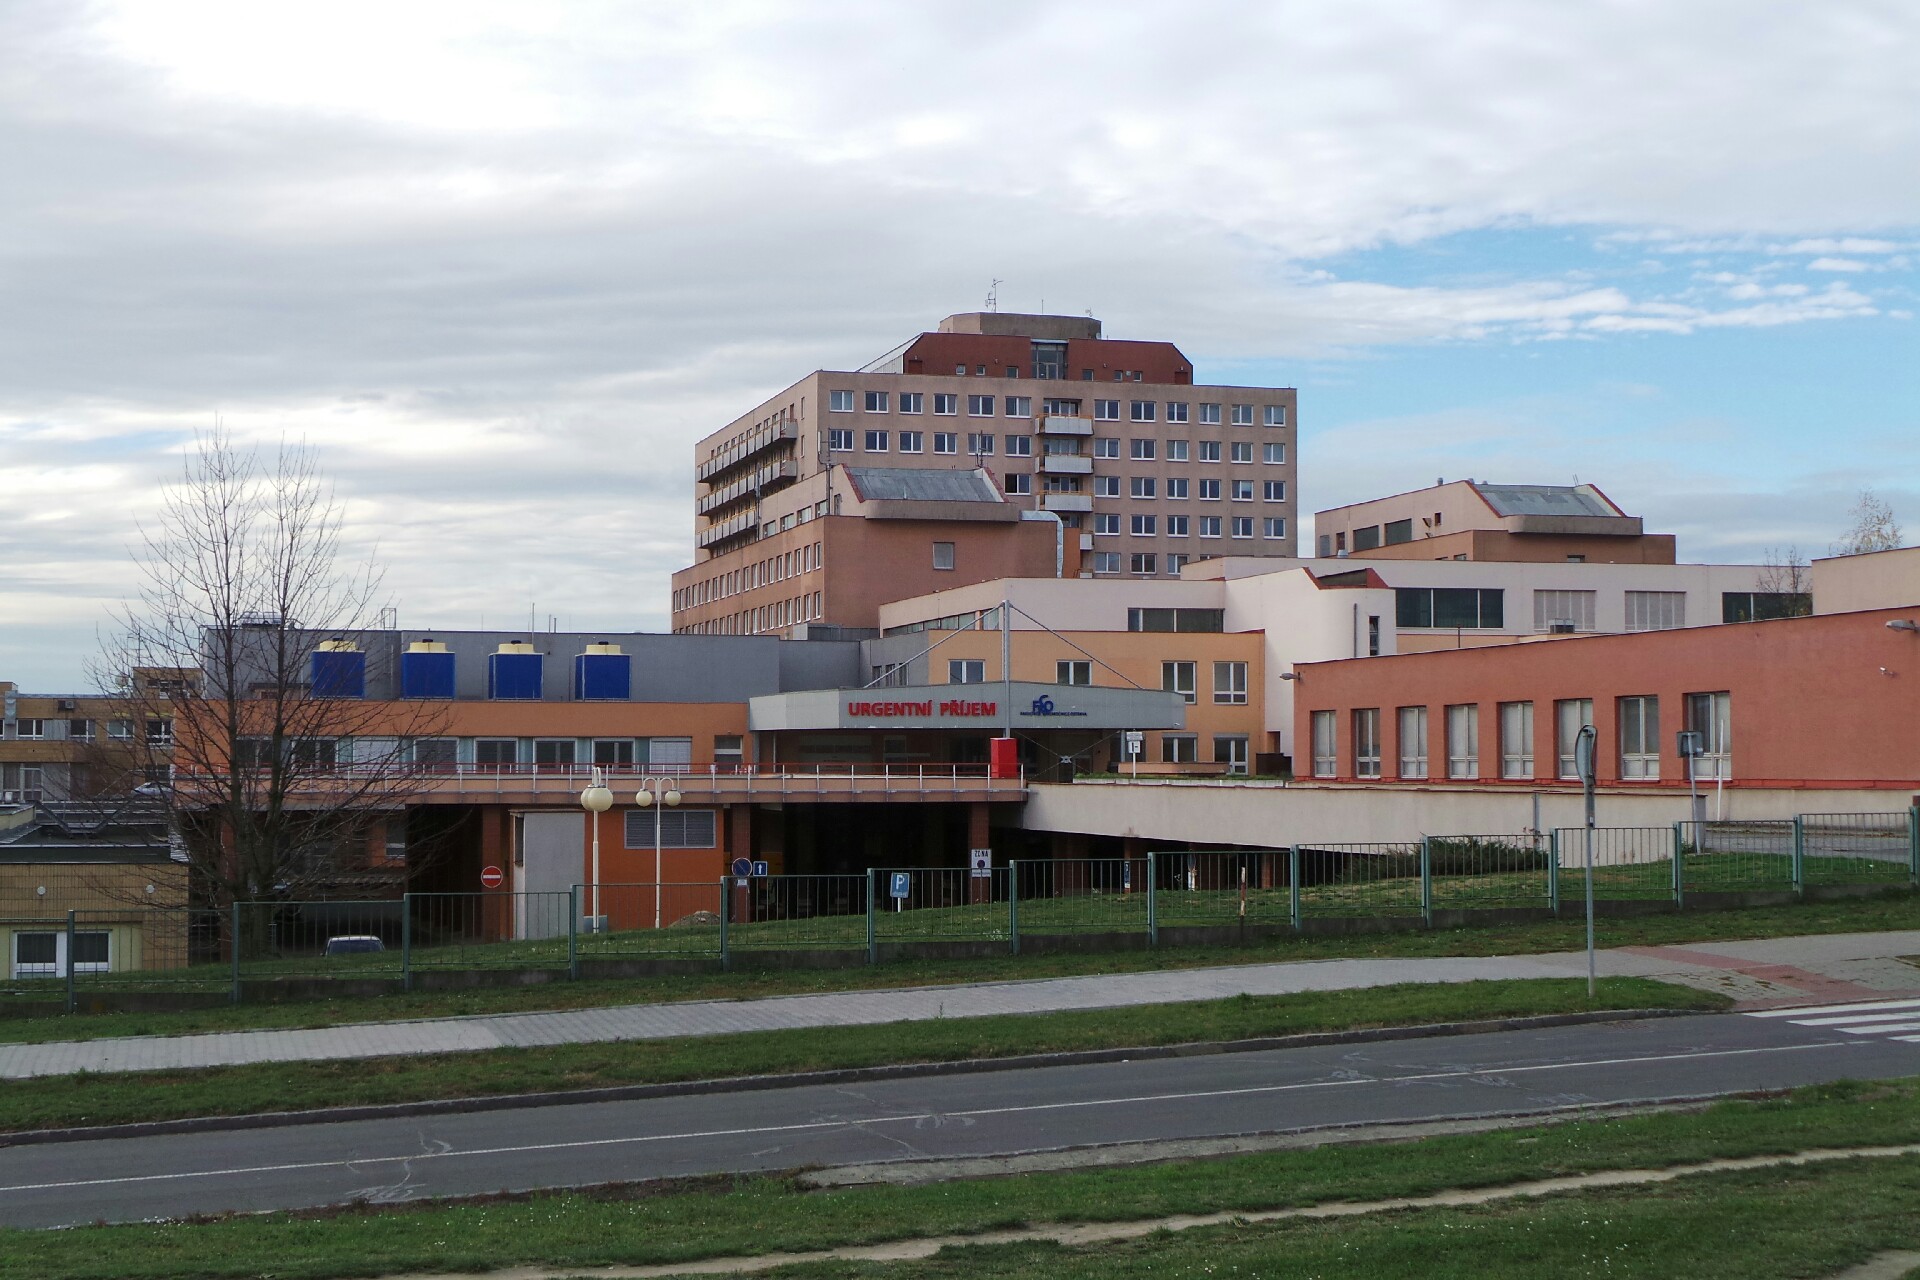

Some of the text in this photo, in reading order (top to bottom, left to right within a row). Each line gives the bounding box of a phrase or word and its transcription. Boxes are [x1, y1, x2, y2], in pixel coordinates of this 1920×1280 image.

[848, 700, 996, 716] URGENTNÍ PŘÍJEM
[896, 874, 905, 890] P
